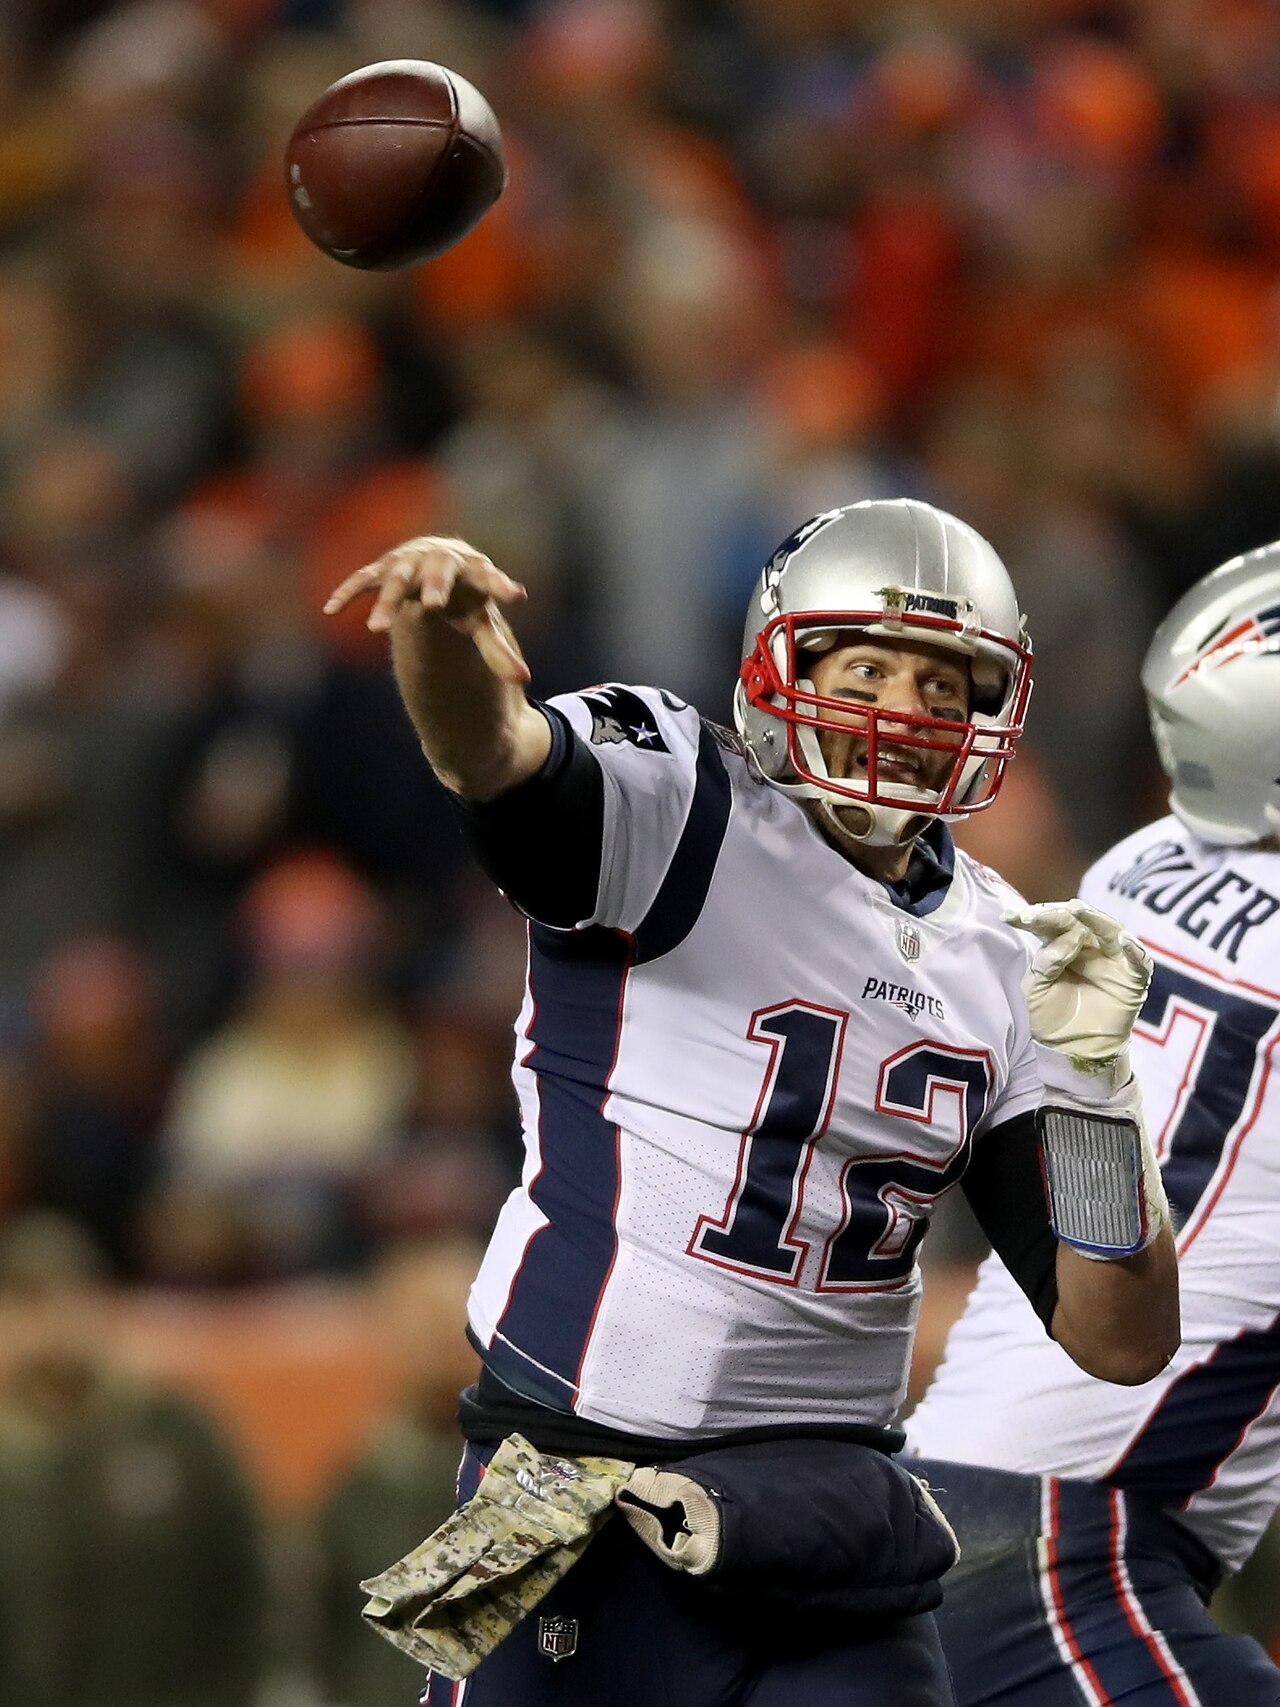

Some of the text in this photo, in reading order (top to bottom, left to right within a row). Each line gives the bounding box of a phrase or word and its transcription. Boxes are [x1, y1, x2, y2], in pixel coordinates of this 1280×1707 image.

[901, 934, 920, 958] NFL
[861, 977, 945, 1021] PATRIOTS
[686, 997, 996, 1293] 12
